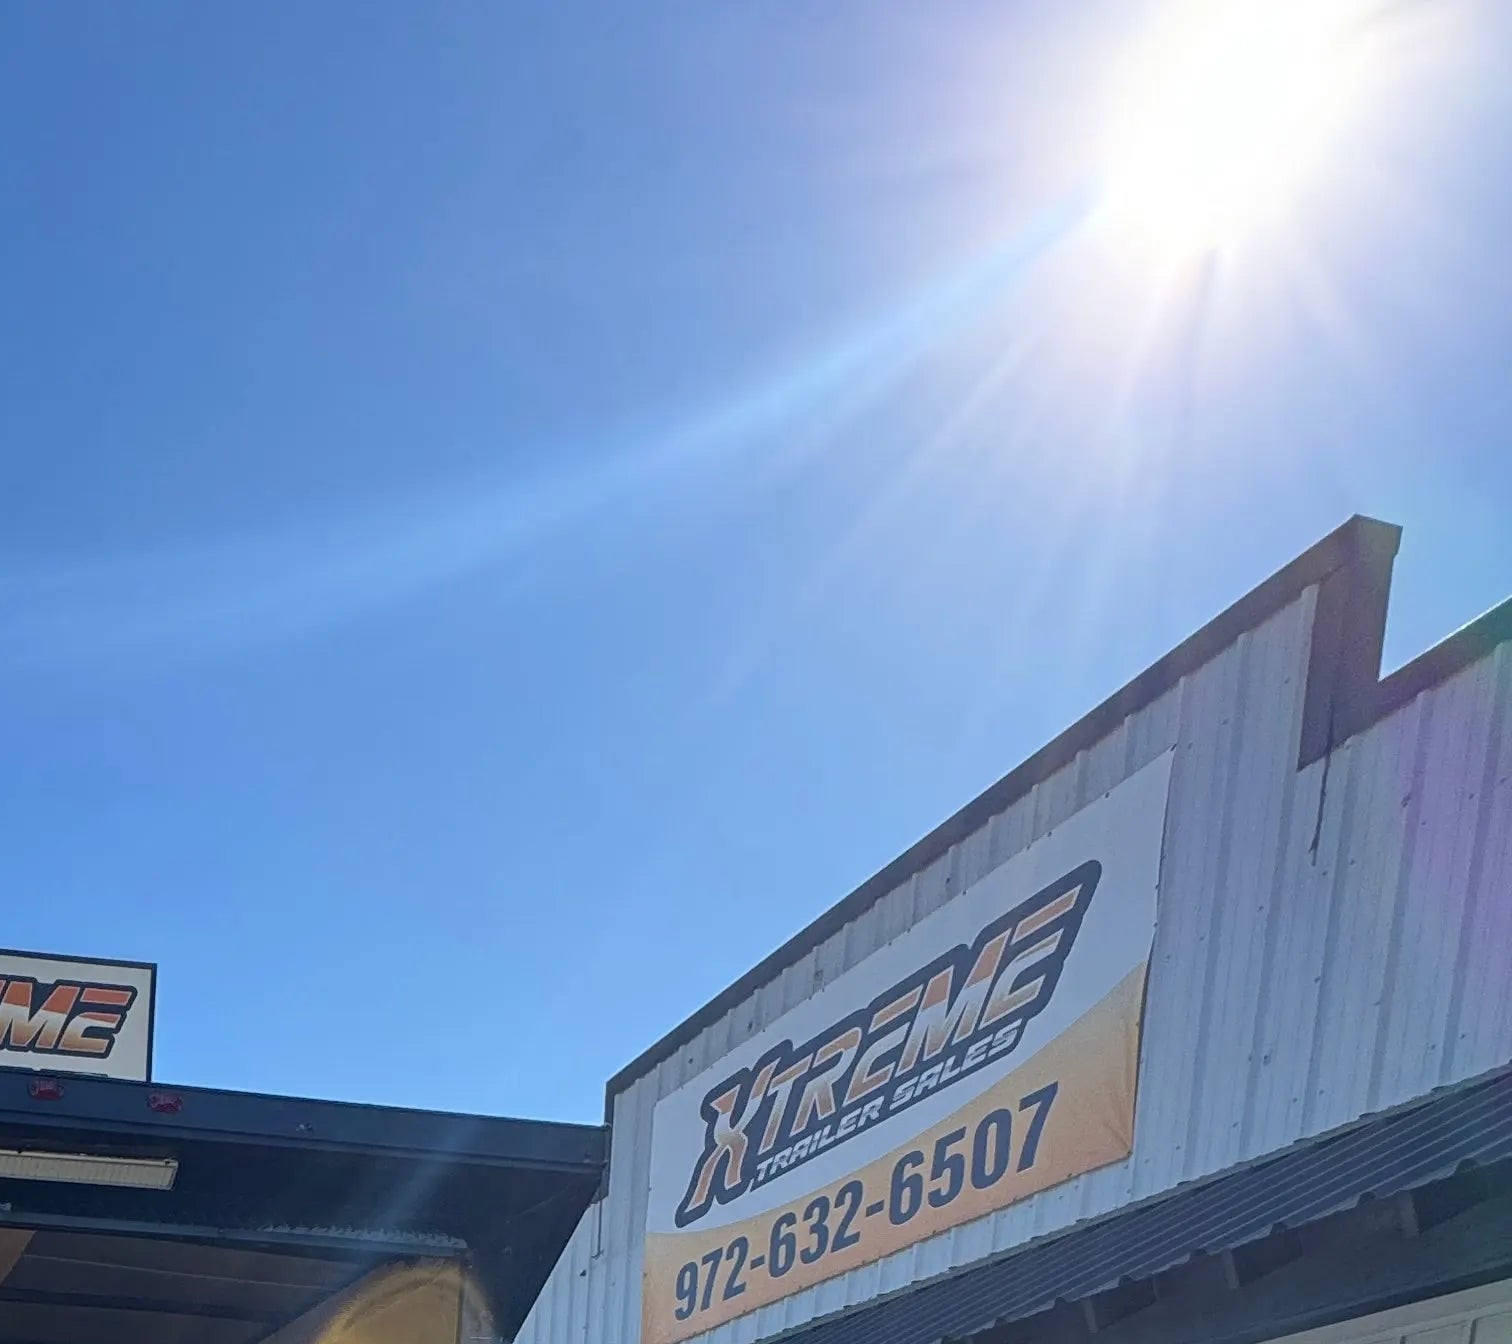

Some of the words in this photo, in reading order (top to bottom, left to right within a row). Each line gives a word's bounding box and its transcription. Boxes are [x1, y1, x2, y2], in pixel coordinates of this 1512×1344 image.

[682, 880, 1085, 1211] XTREME
[755, 1095, 885, 1183] TRAILER
[892, 1017, 1024, 1110] SALES
[674, 1081, 1060, 1322] 972-632-6507
